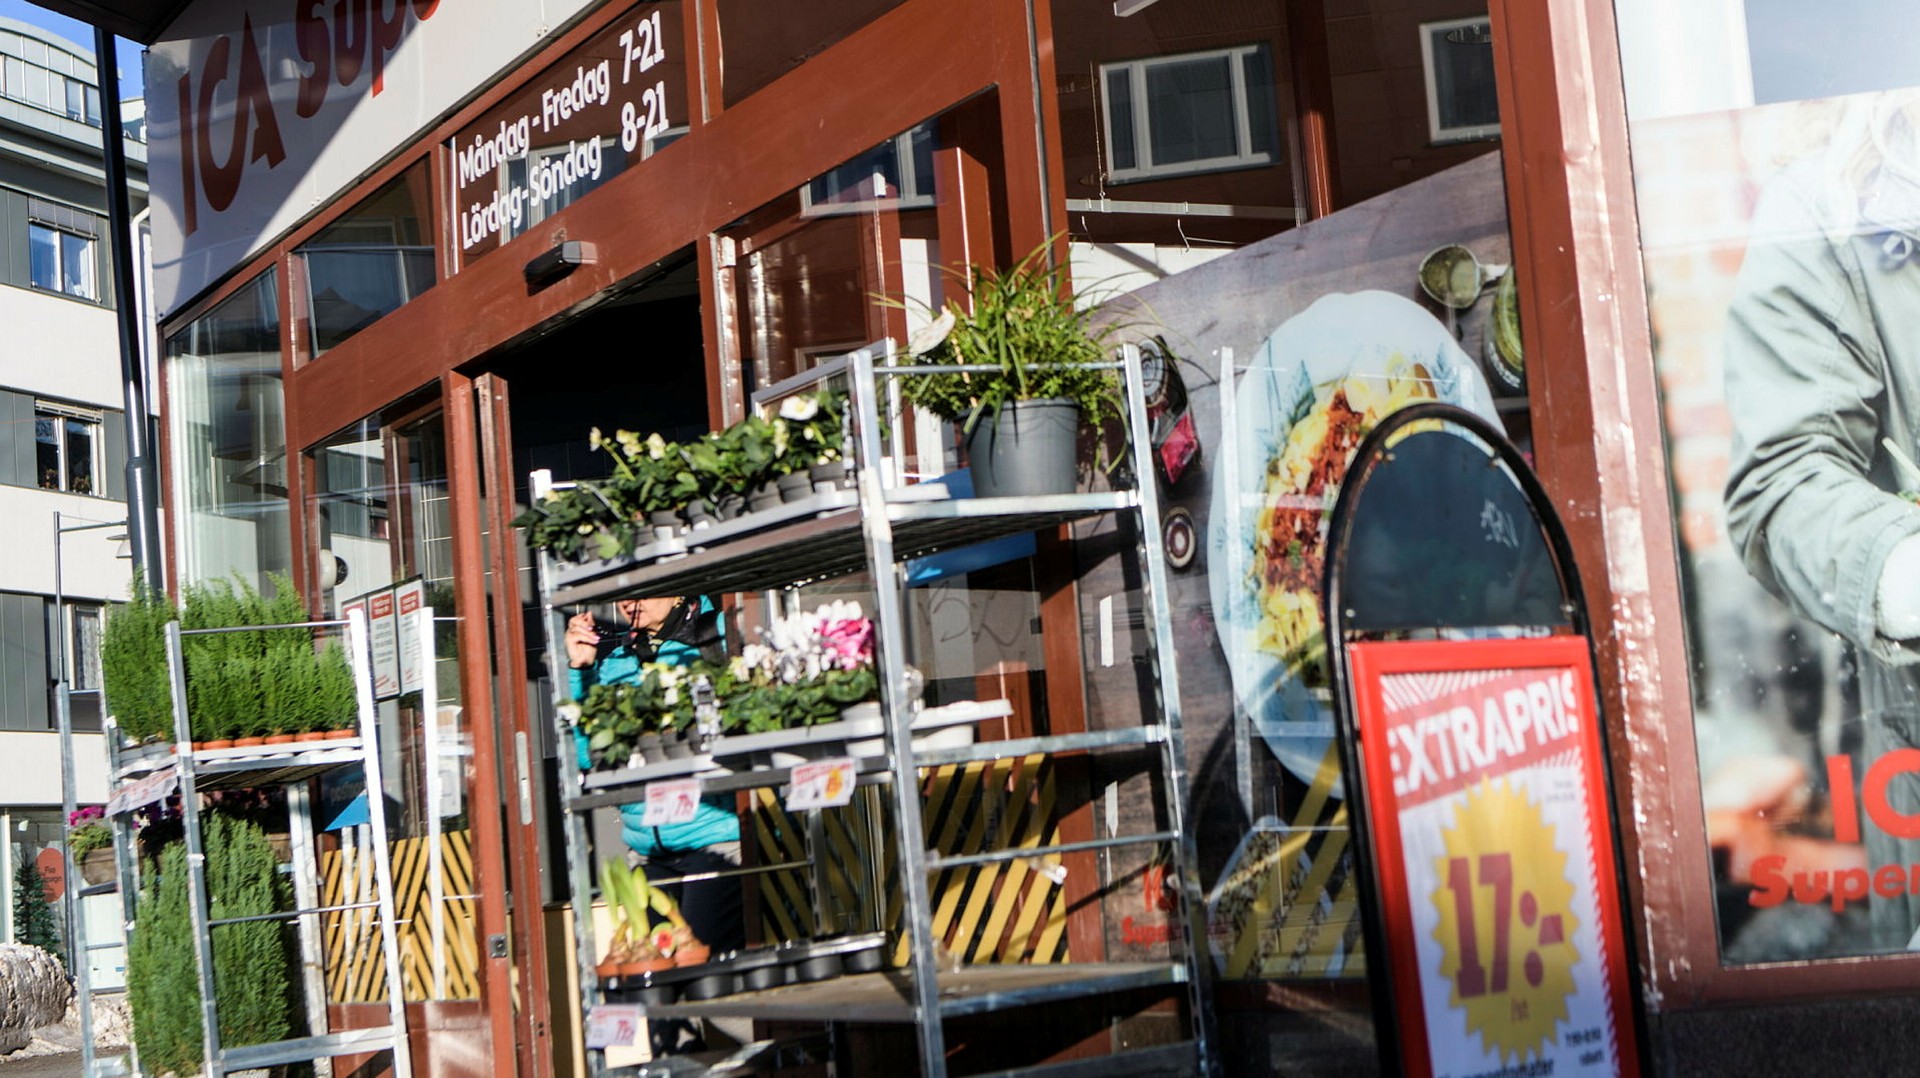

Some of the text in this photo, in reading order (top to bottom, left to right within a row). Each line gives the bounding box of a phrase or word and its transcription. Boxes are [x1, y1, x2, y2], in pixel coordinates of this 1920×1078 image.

[178, 0, 441, 238] ICA Sup
[459, 115, 530, 189] Måndag
[542, 59, 610, 133] Fredag
[619, 10, 665, 84] 7-21
[621, 80, 669, 152] 8-21
